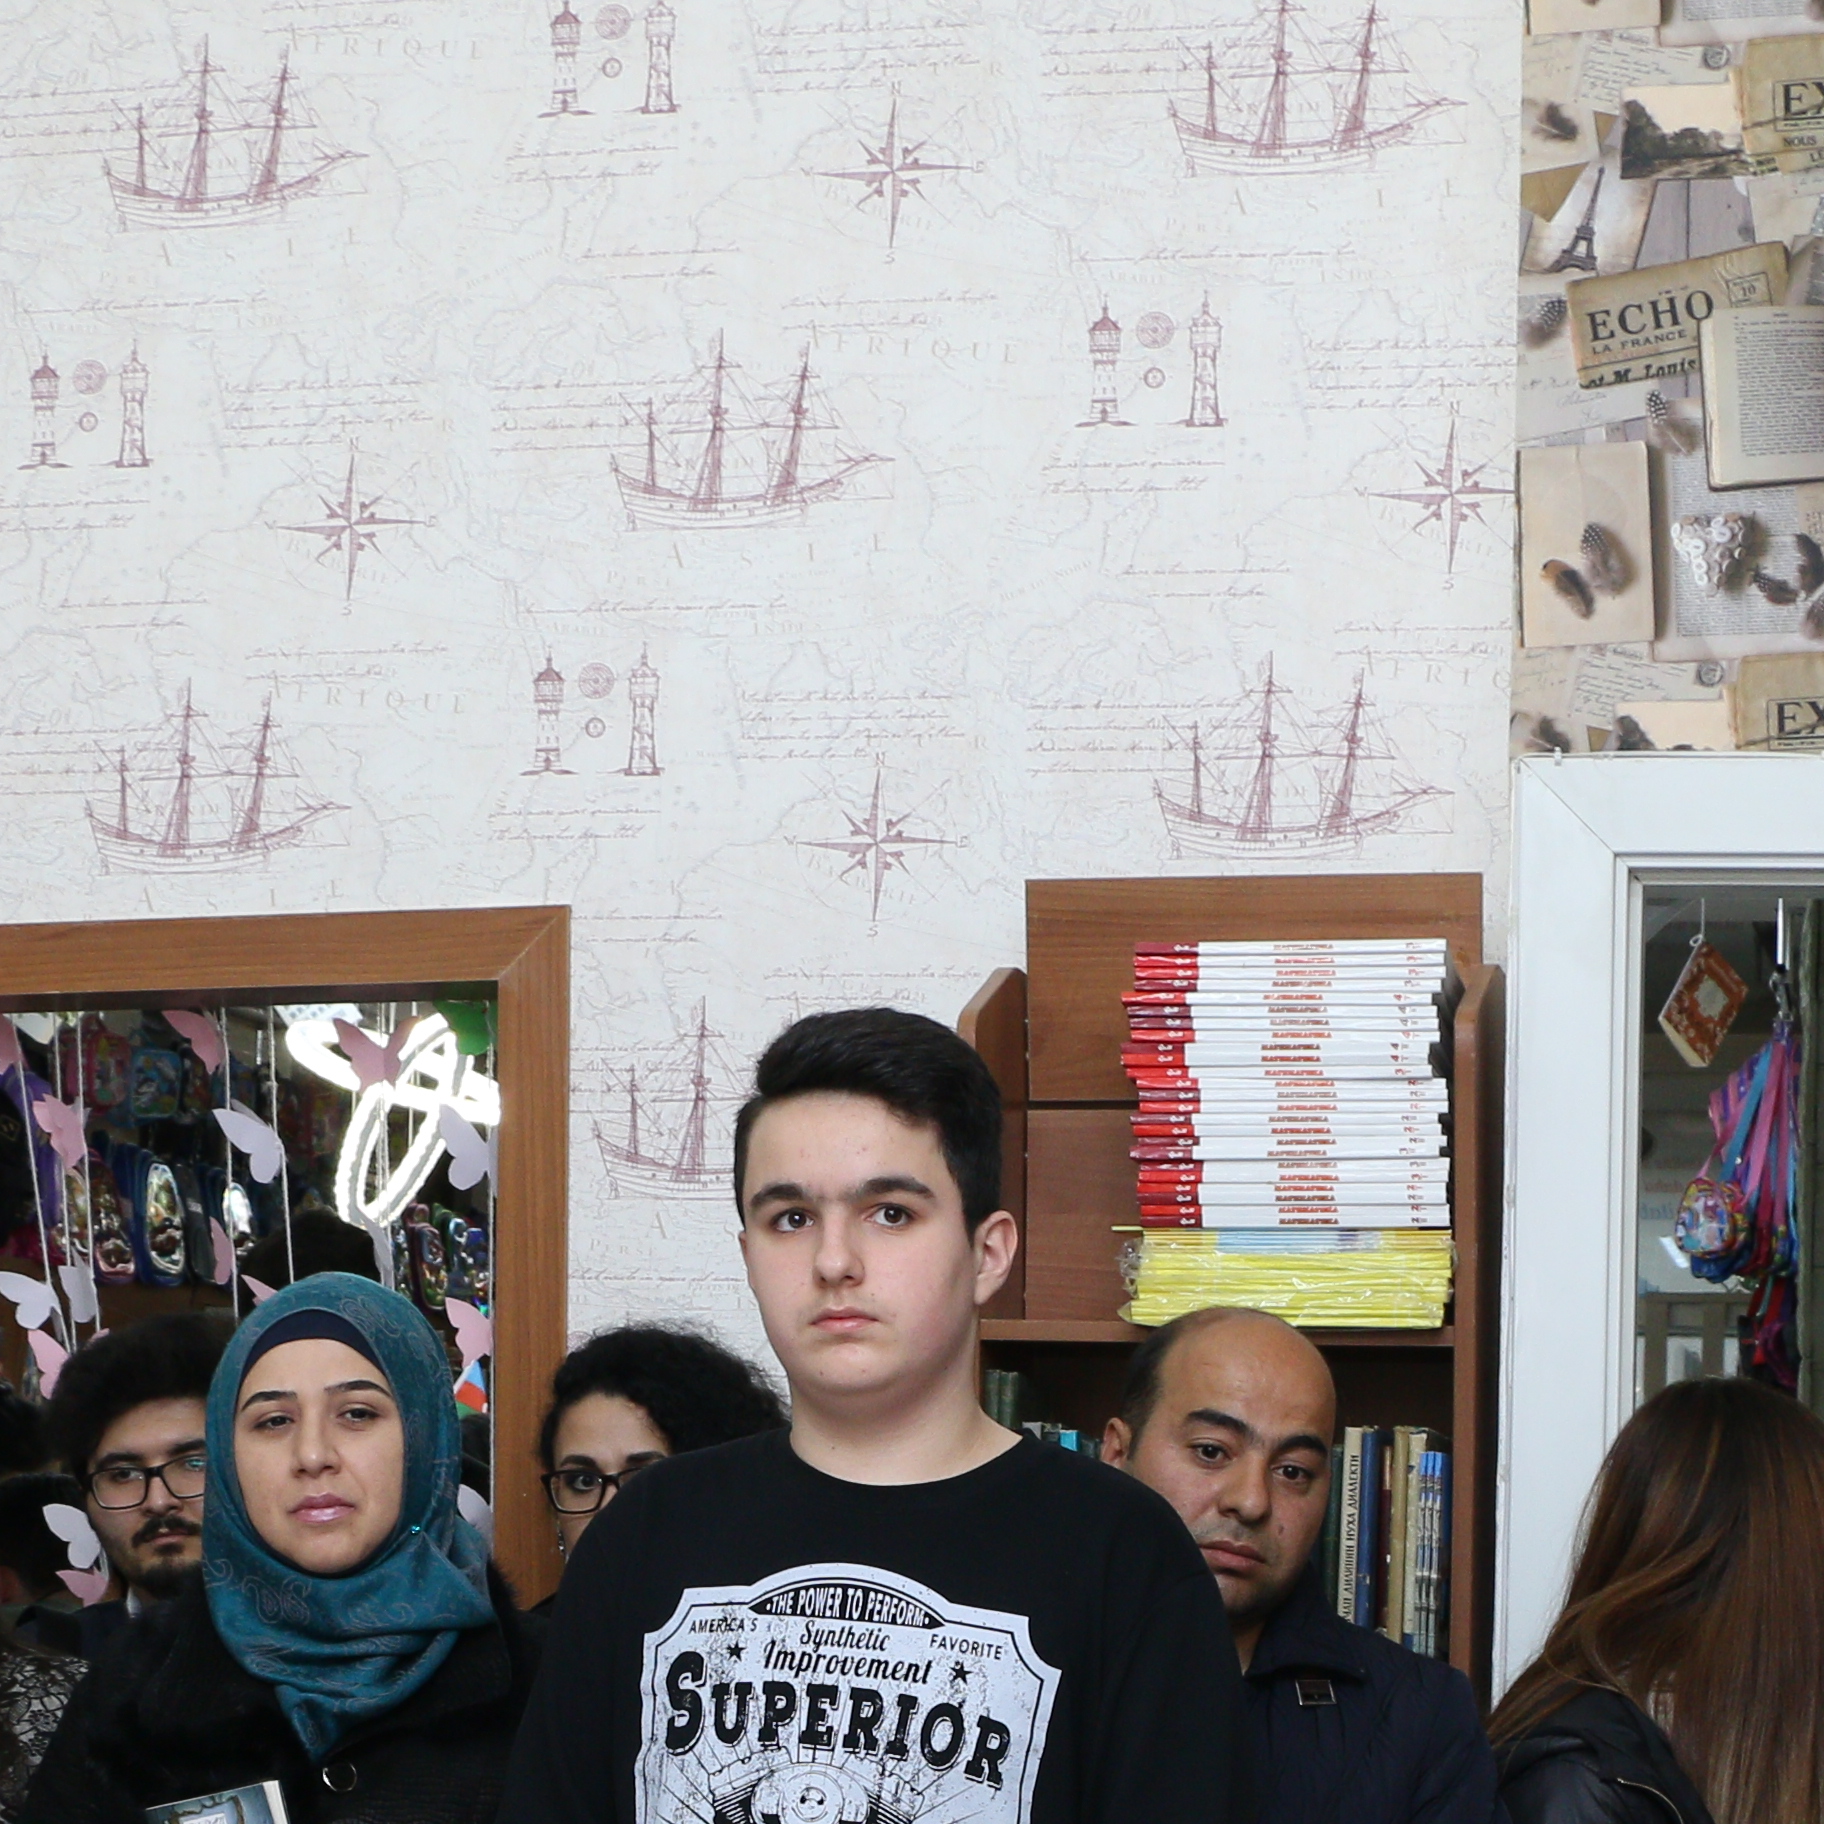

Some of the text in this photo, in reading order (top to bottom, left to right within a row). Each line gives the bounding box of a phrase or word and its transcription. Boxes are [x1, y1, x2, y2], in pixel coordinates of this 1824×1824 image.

[1585, 289, 1715, 343] ECHO
[1620, 328, 1688, 351] FRANCE
[771, 1586, 925, 1627] THE POWER TO PERFORM
[799, 1619, 892, 1652] Synthetic
[929, 1632, 1004, 1660] FAVORITE
[763, 1638, 933, 1685] Improvement
